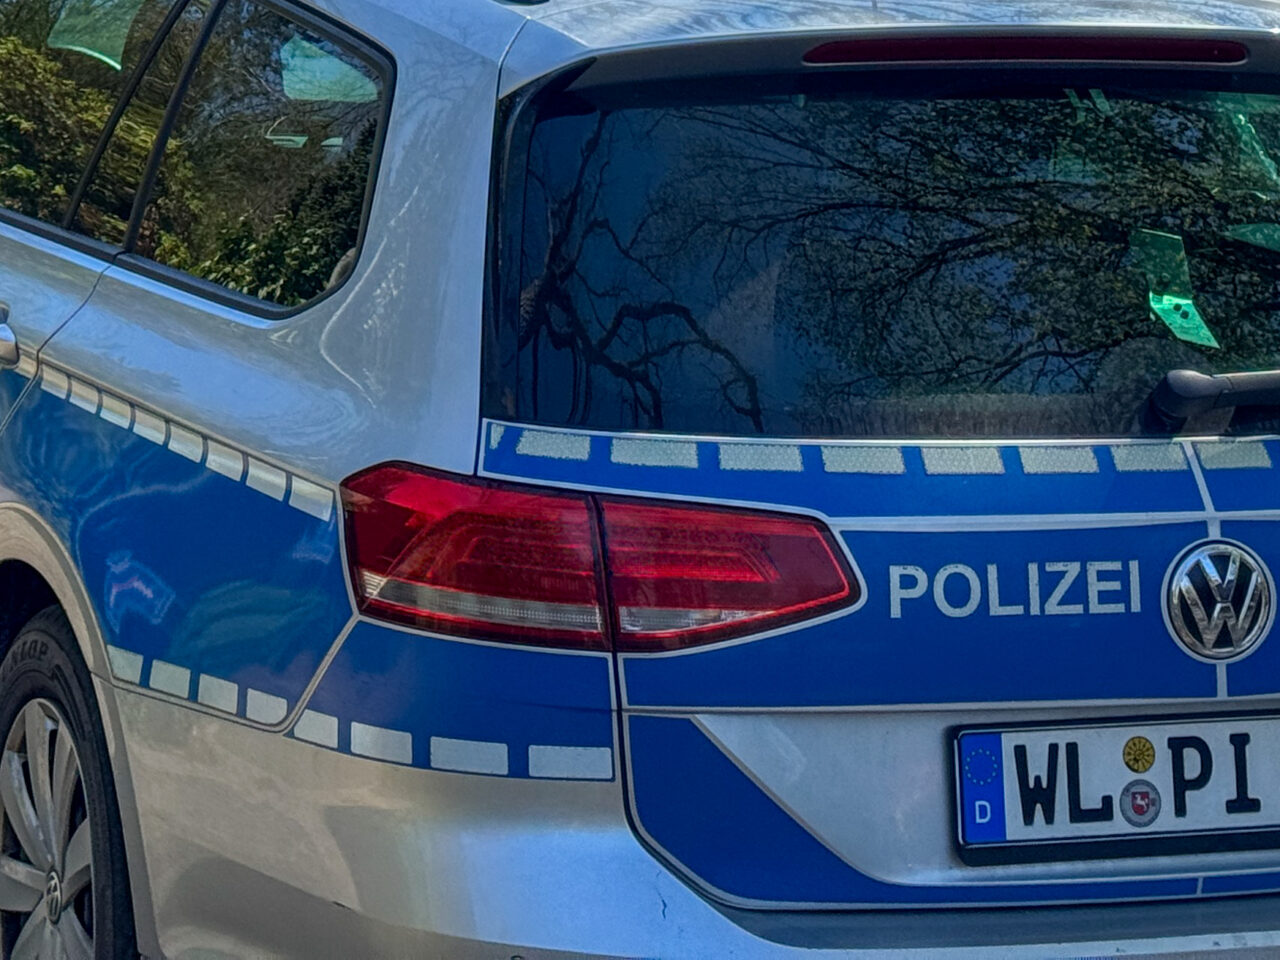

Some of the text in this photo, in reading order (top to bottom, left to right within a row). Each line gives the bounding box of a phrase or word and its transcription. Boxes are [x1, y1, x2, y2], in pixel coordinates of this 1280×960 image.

[888, 559, 1142, 619] POLIZEI
[1013, 732, 1262, 826] WL PI
[974, 800, 992, 824] D
